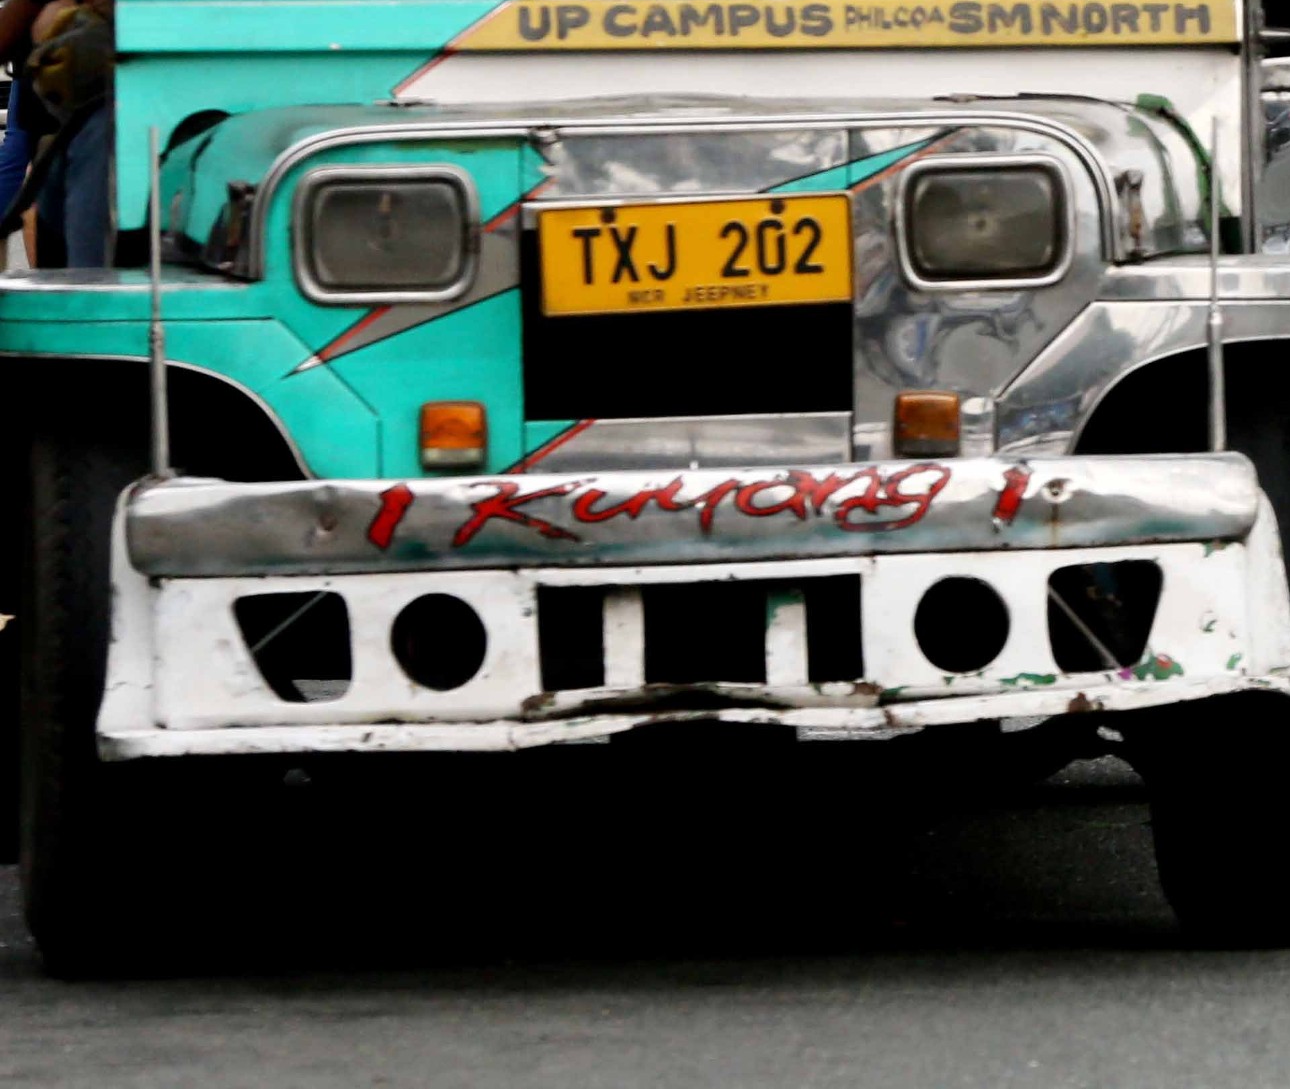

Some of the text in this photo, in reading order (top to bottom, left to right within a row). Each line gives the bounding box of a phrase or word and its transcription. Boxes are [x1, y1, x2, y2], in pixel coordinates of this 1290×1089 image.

[516, 0, 1211, 42] UP CAMPUS PHILCOA SM NORTH
[571, 216, 825, 286] TXJ 202
[627, 283, 770, 305] NCR JEEPNEY
